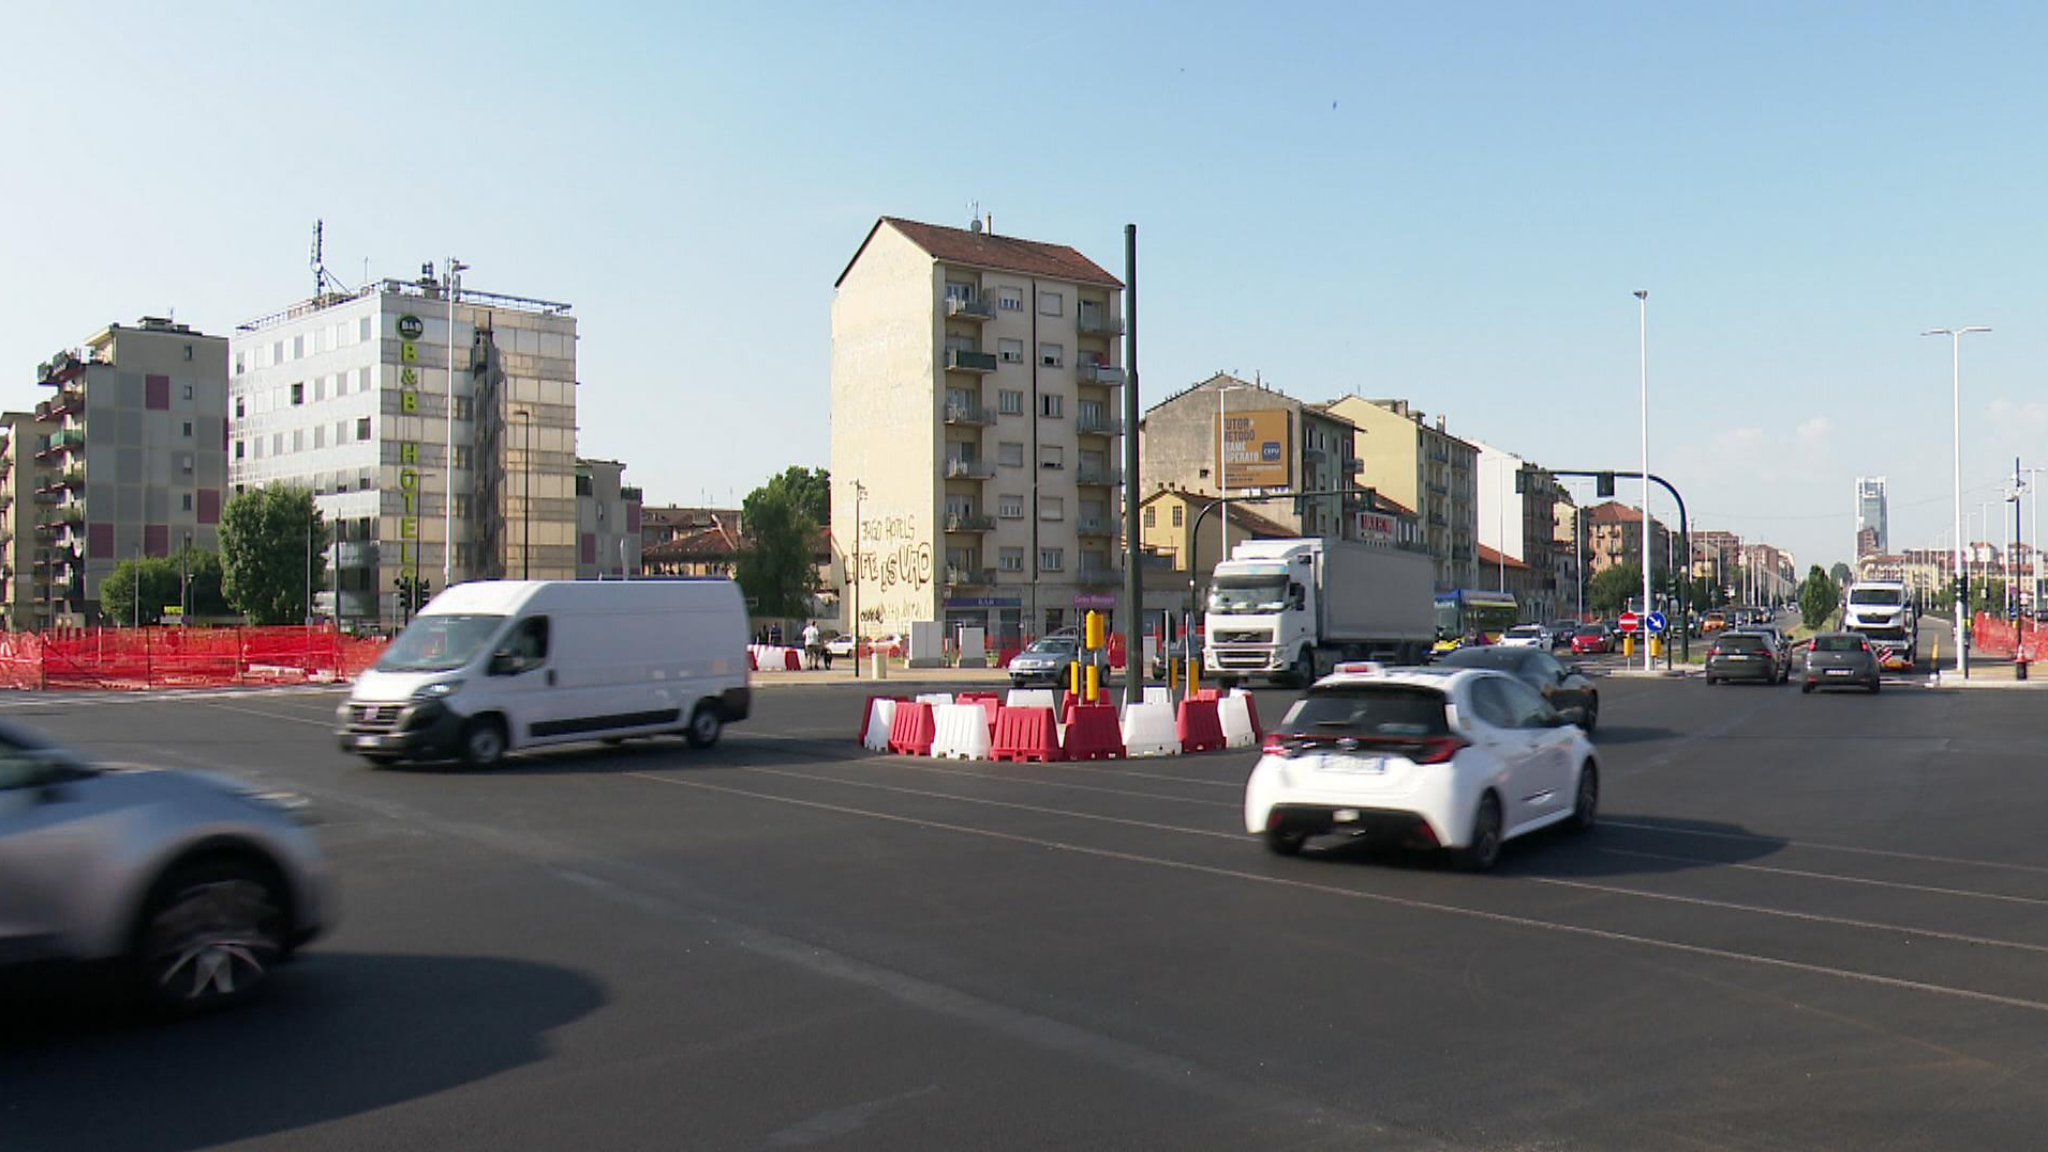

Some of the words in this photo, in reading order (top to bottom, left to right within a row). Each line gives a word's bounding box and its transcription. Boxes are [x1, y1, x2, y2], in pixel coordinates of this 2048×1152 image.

[401, 341, 418, 413] B&B
[1225, 418, 1249, 430] UTOR
[1225, 442, 1246, 452] SAME
[1225, 452, 1259, 462] UPERATO
